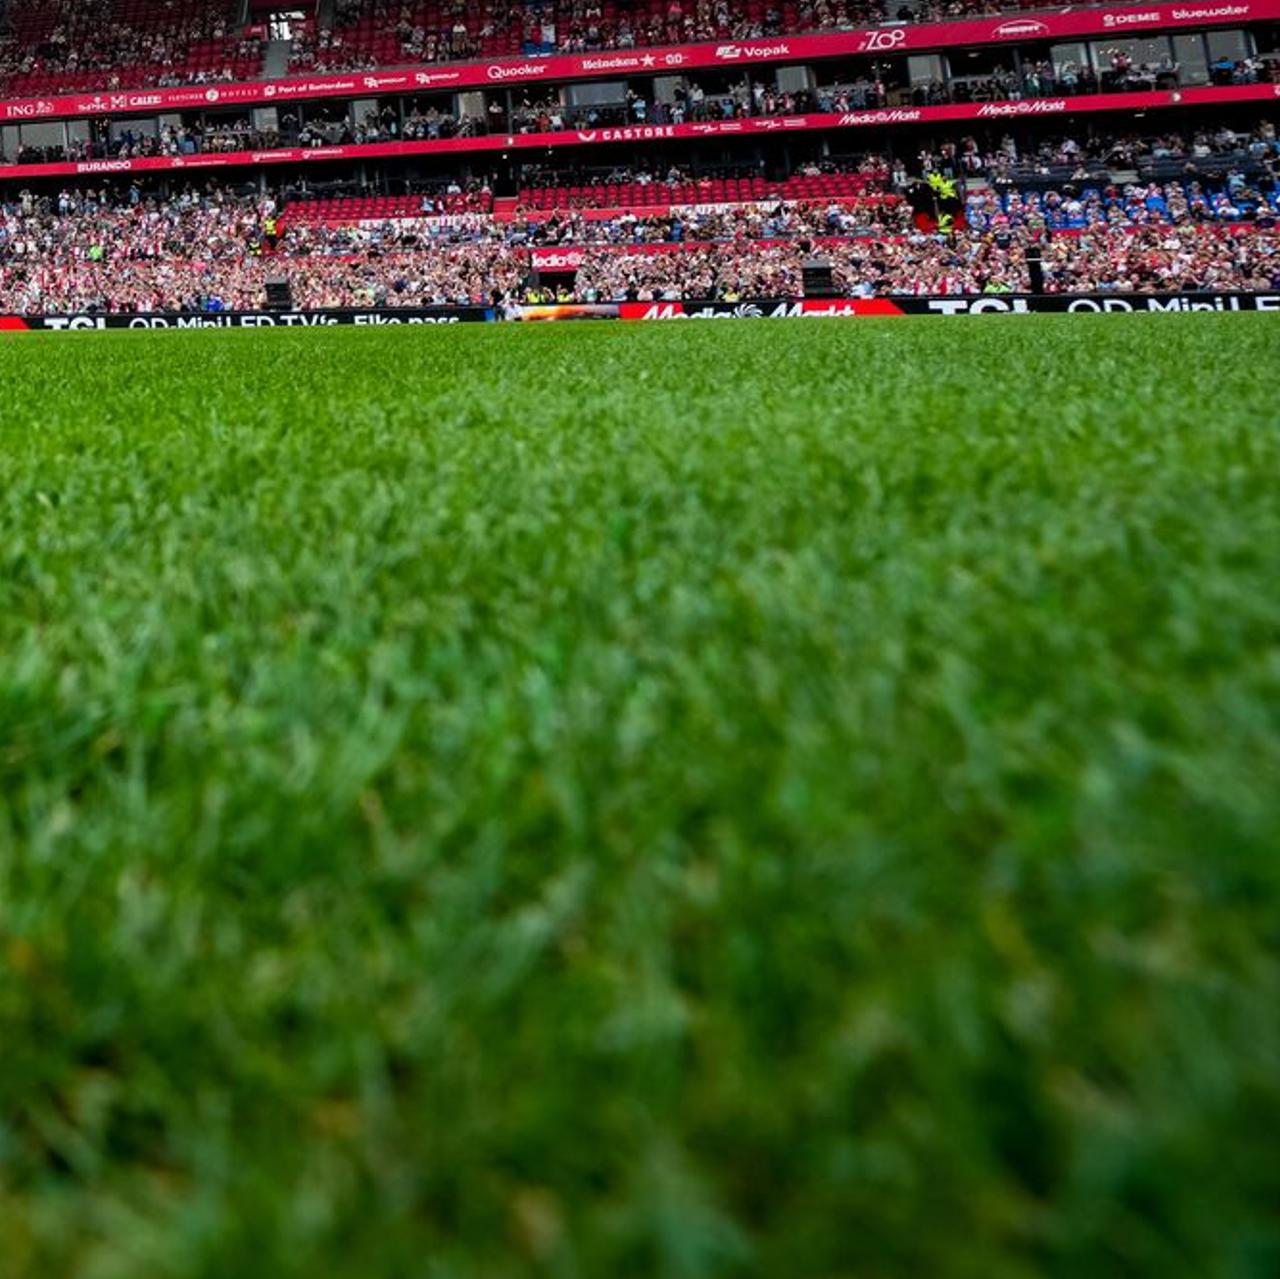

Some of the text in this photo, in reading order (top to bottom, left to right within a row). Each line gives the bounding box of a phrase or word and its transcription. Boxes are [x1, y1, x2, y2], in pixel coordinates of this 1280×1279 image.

[1172, 5, 1249, 19] bluewater
[744, 45, 789, 58] Vopak
[582, 57, 638, 70] Heineken
[487, 63, 546, 80] Quooker
[7, 104, 34, 117] ING
[602, 126, 674, 141] CASTORE
[77, 160, 131, 173] BURANDO
